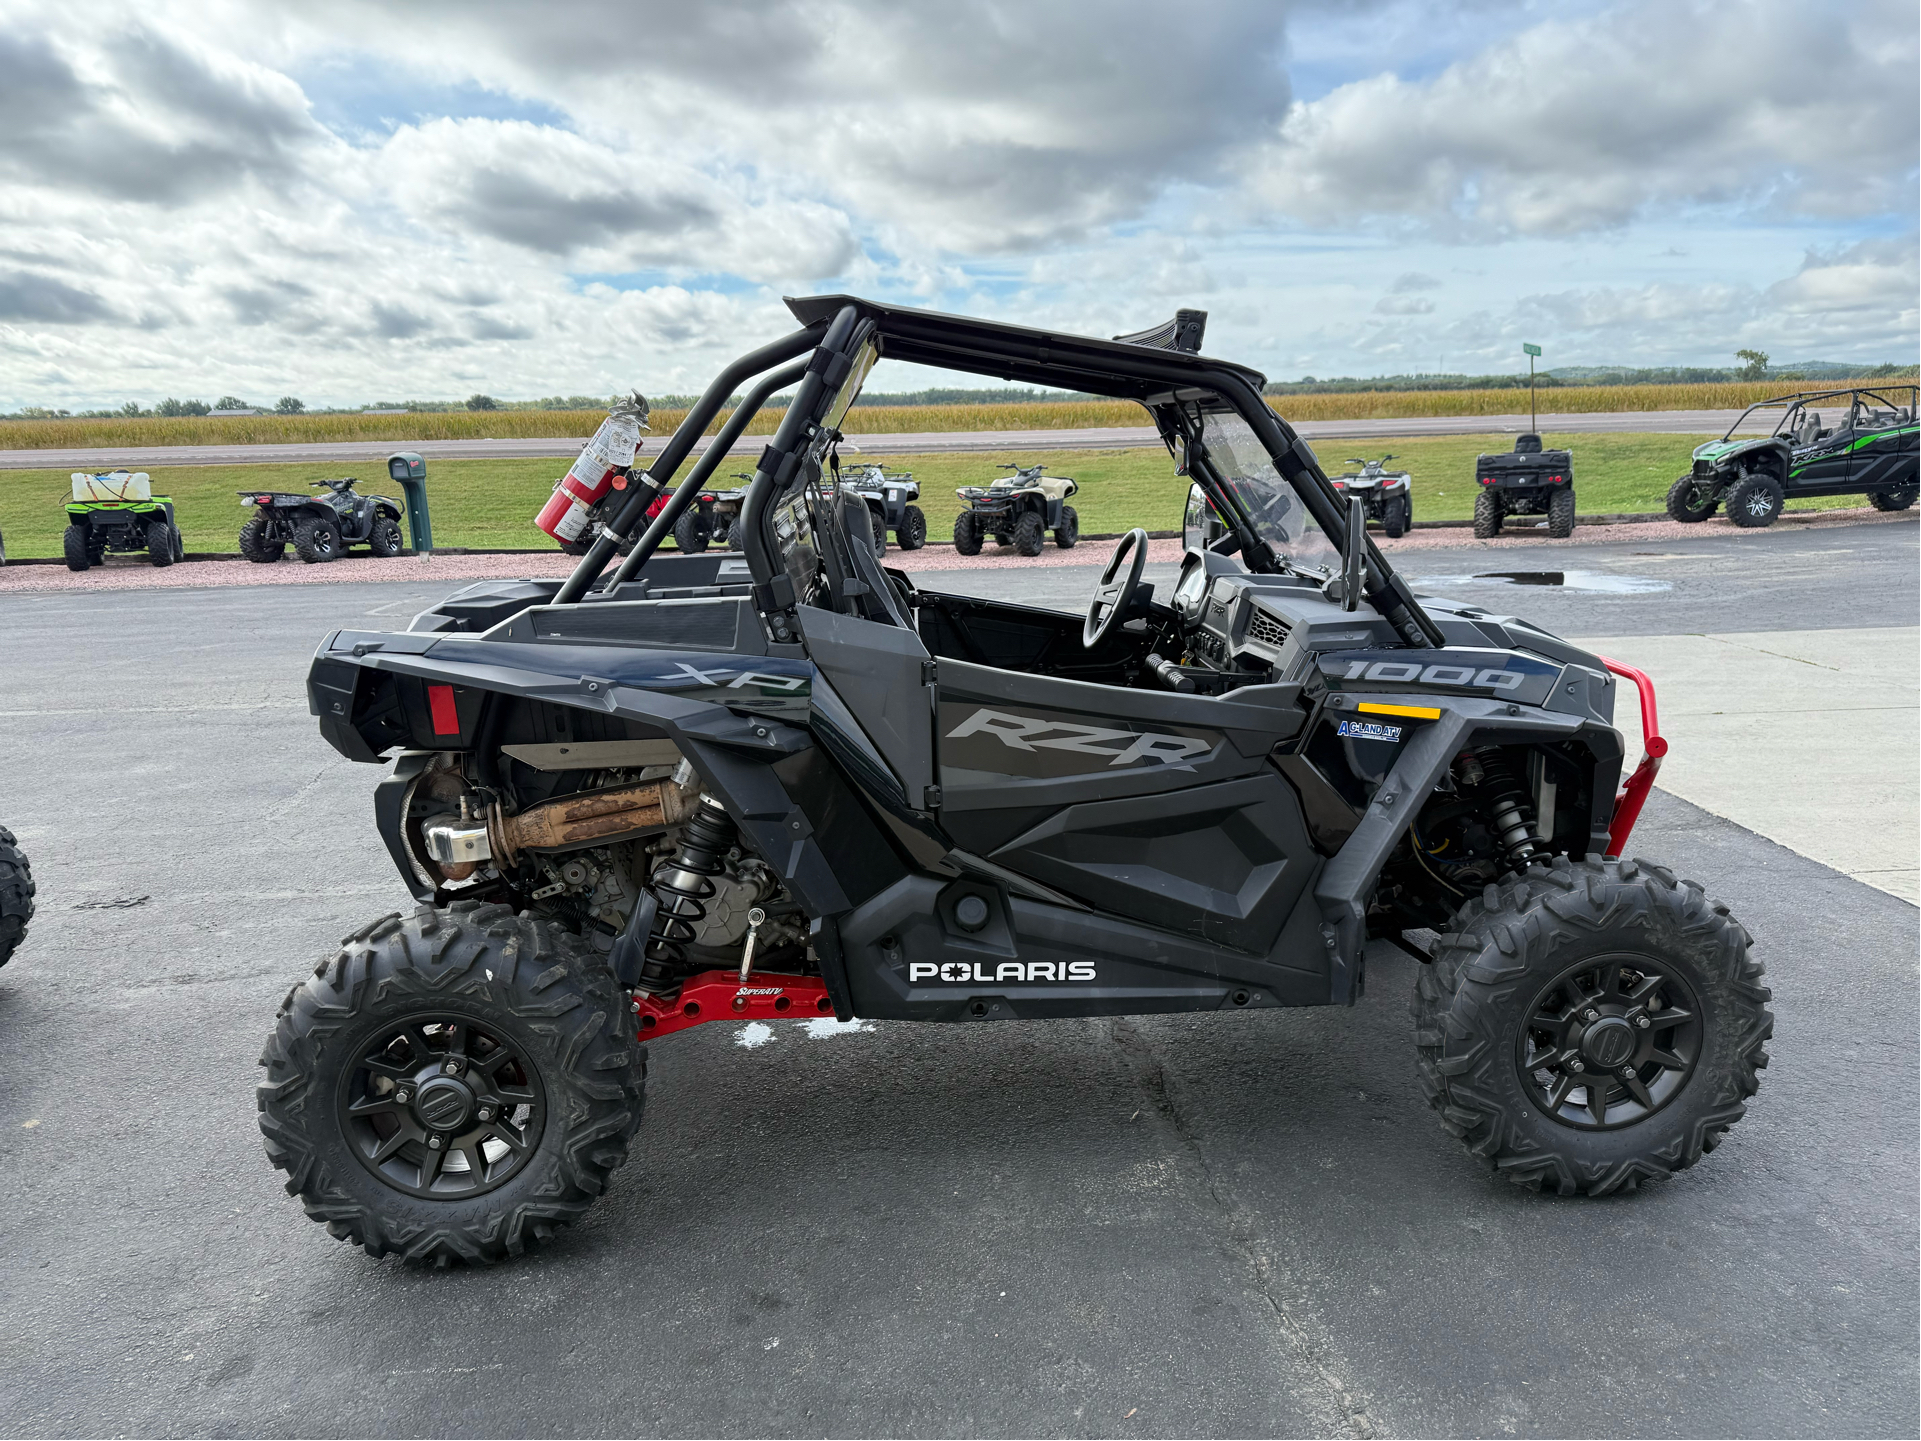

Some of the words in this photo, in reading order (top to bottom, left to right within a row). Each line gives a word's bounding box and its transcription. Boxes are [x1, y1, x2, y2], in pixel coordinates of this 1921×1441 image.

[655, 662, 807, 691] XP
[1343, 661, 1525, 690] 1000
[945, 708, 1212, 773] RZR
[1382, 725, 1402, 738] ATV
[909, 961, 1097, 982] POLARIS
